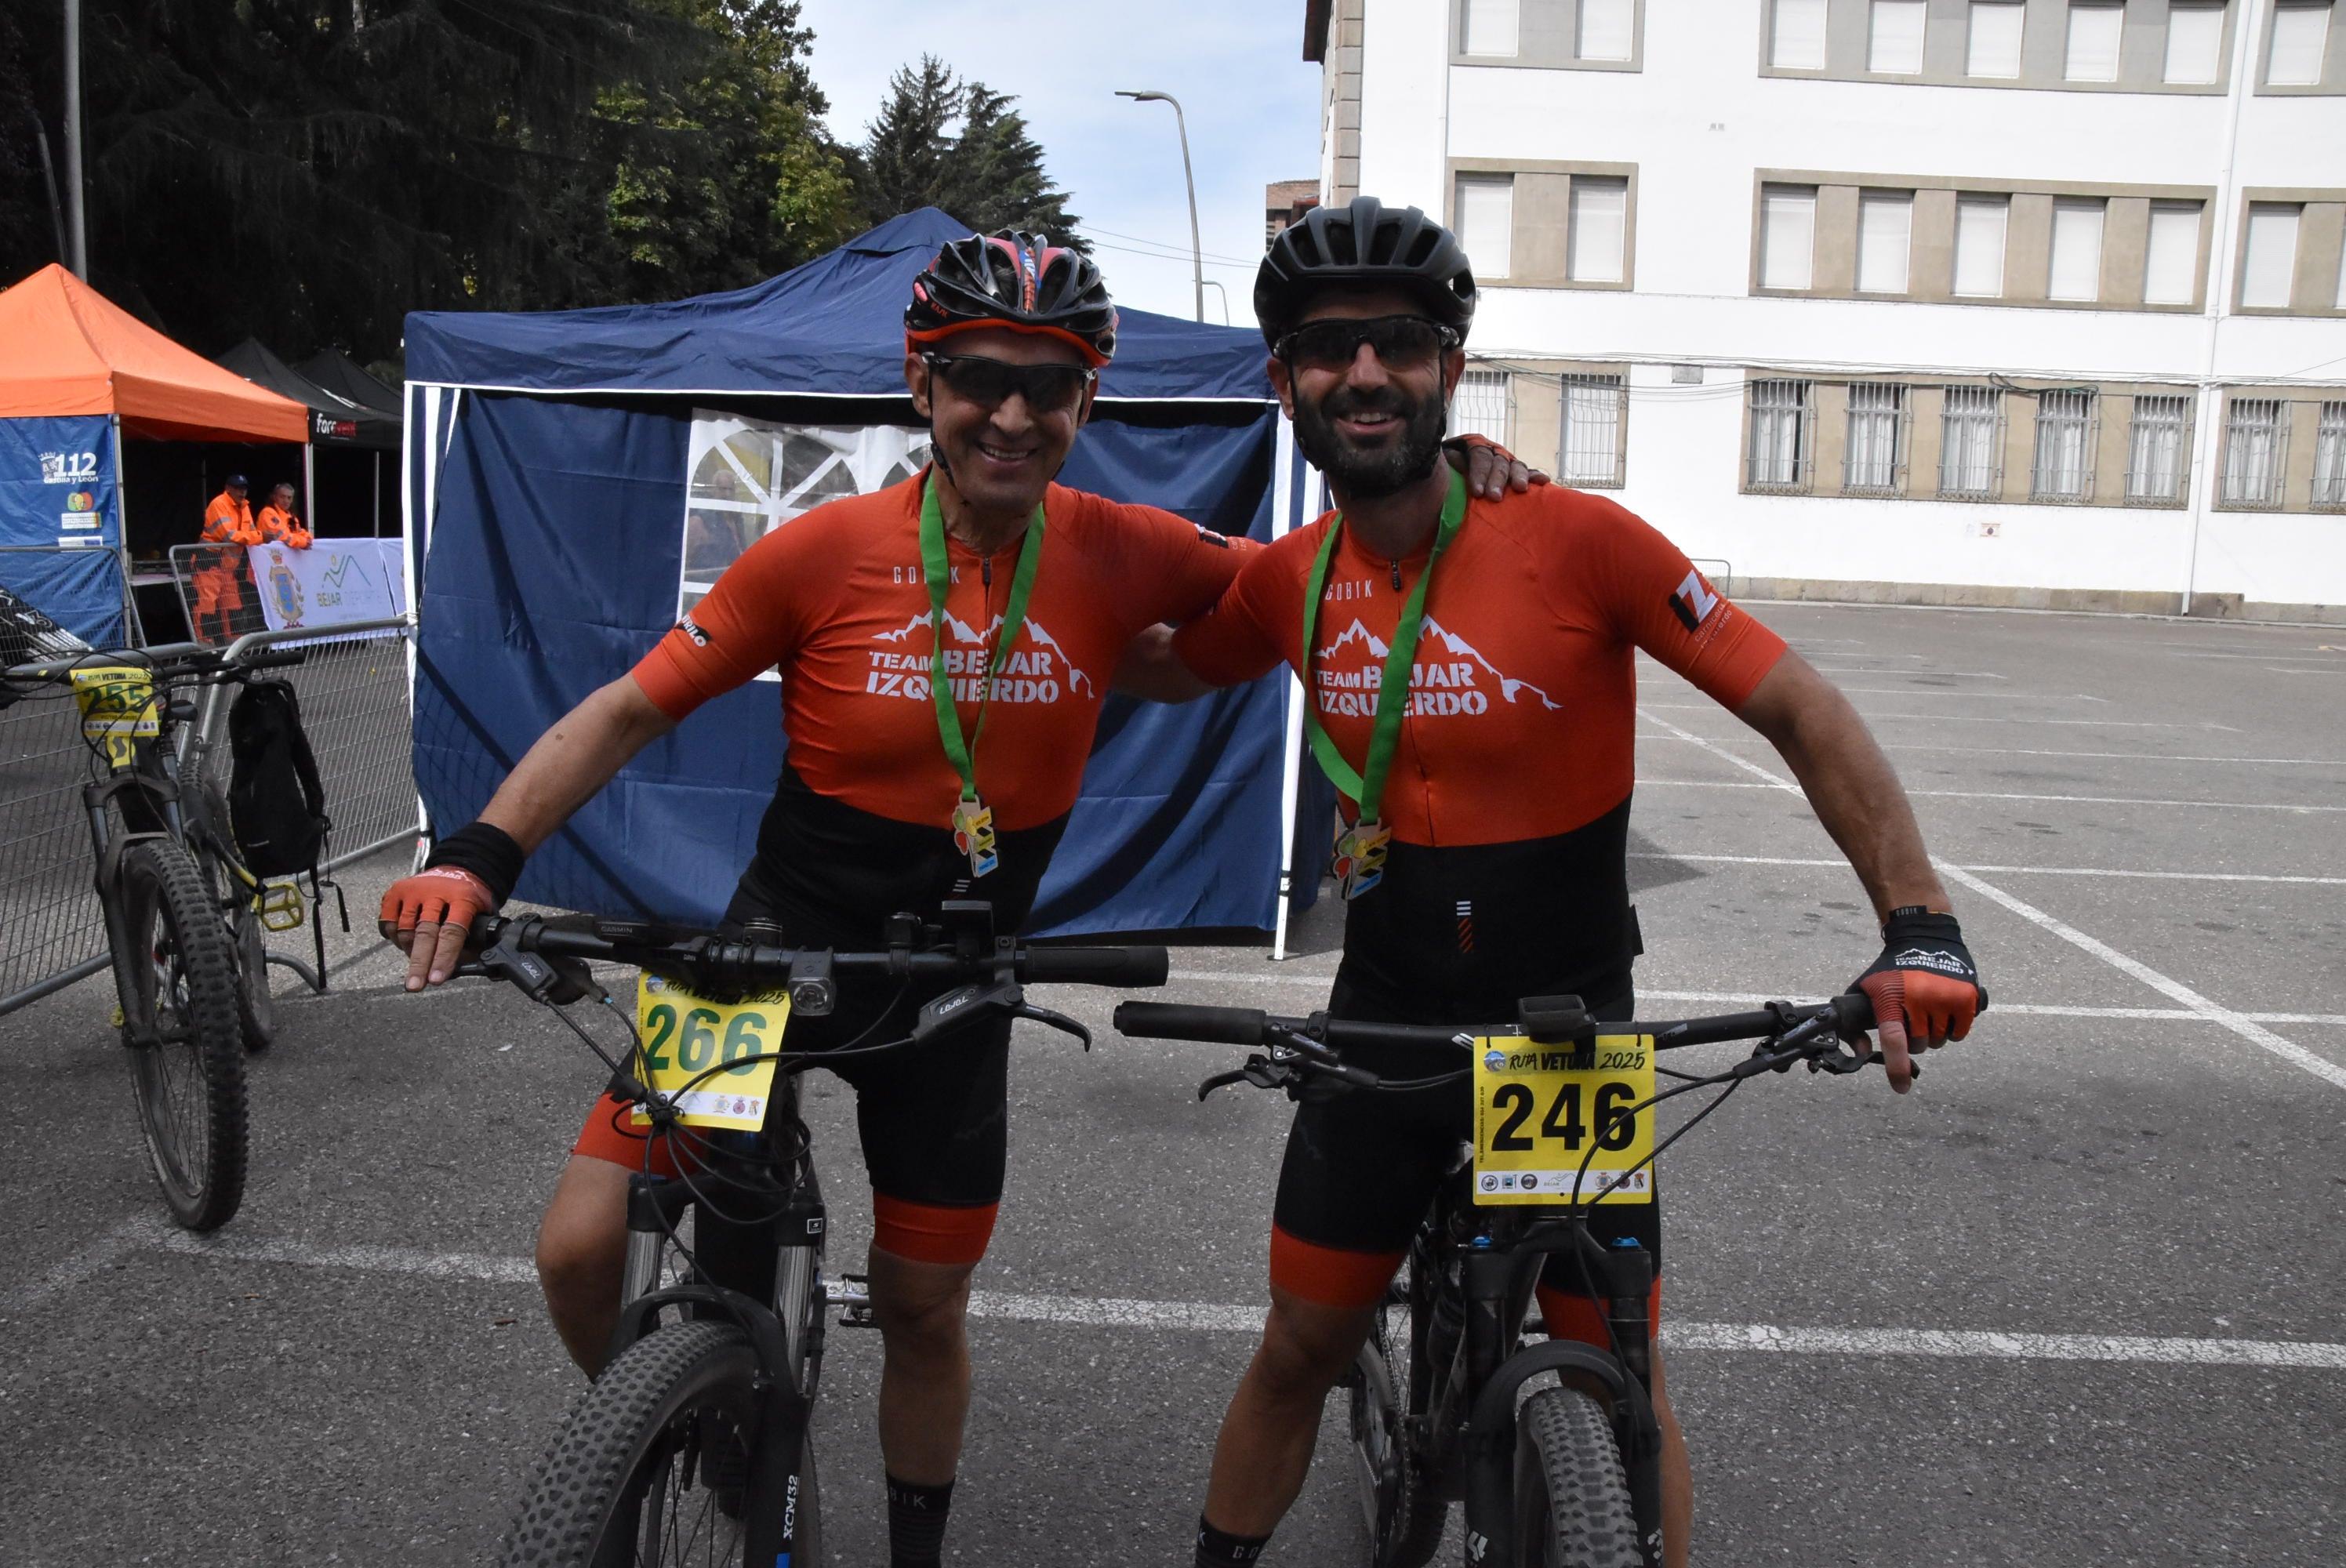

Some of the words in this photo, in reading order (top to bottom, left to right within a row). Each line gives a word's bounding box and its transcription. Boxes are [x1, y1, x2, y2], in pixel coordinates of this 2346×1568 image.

[54, 452, 96, 477] 112
[78, 474, 98, 483] León
[1325, 579, 1372, 601] GOBIK
[1363, 662, 1475, 689] BJAR
[82, 684, 146, 713] 255
[1895, 960, 1964, 975] IZQUIERDO
[1918, 955, 1961, 967] BEJAR
[646, 1004, 768, 1076] 266
[1509, 1053, 1538, 1071] RUTA
[1599, 1051, 1646, 1070] 2025
[1491, 1082, 1636, 1152] 246
[783, 1475, 798, 1541] XCM32
